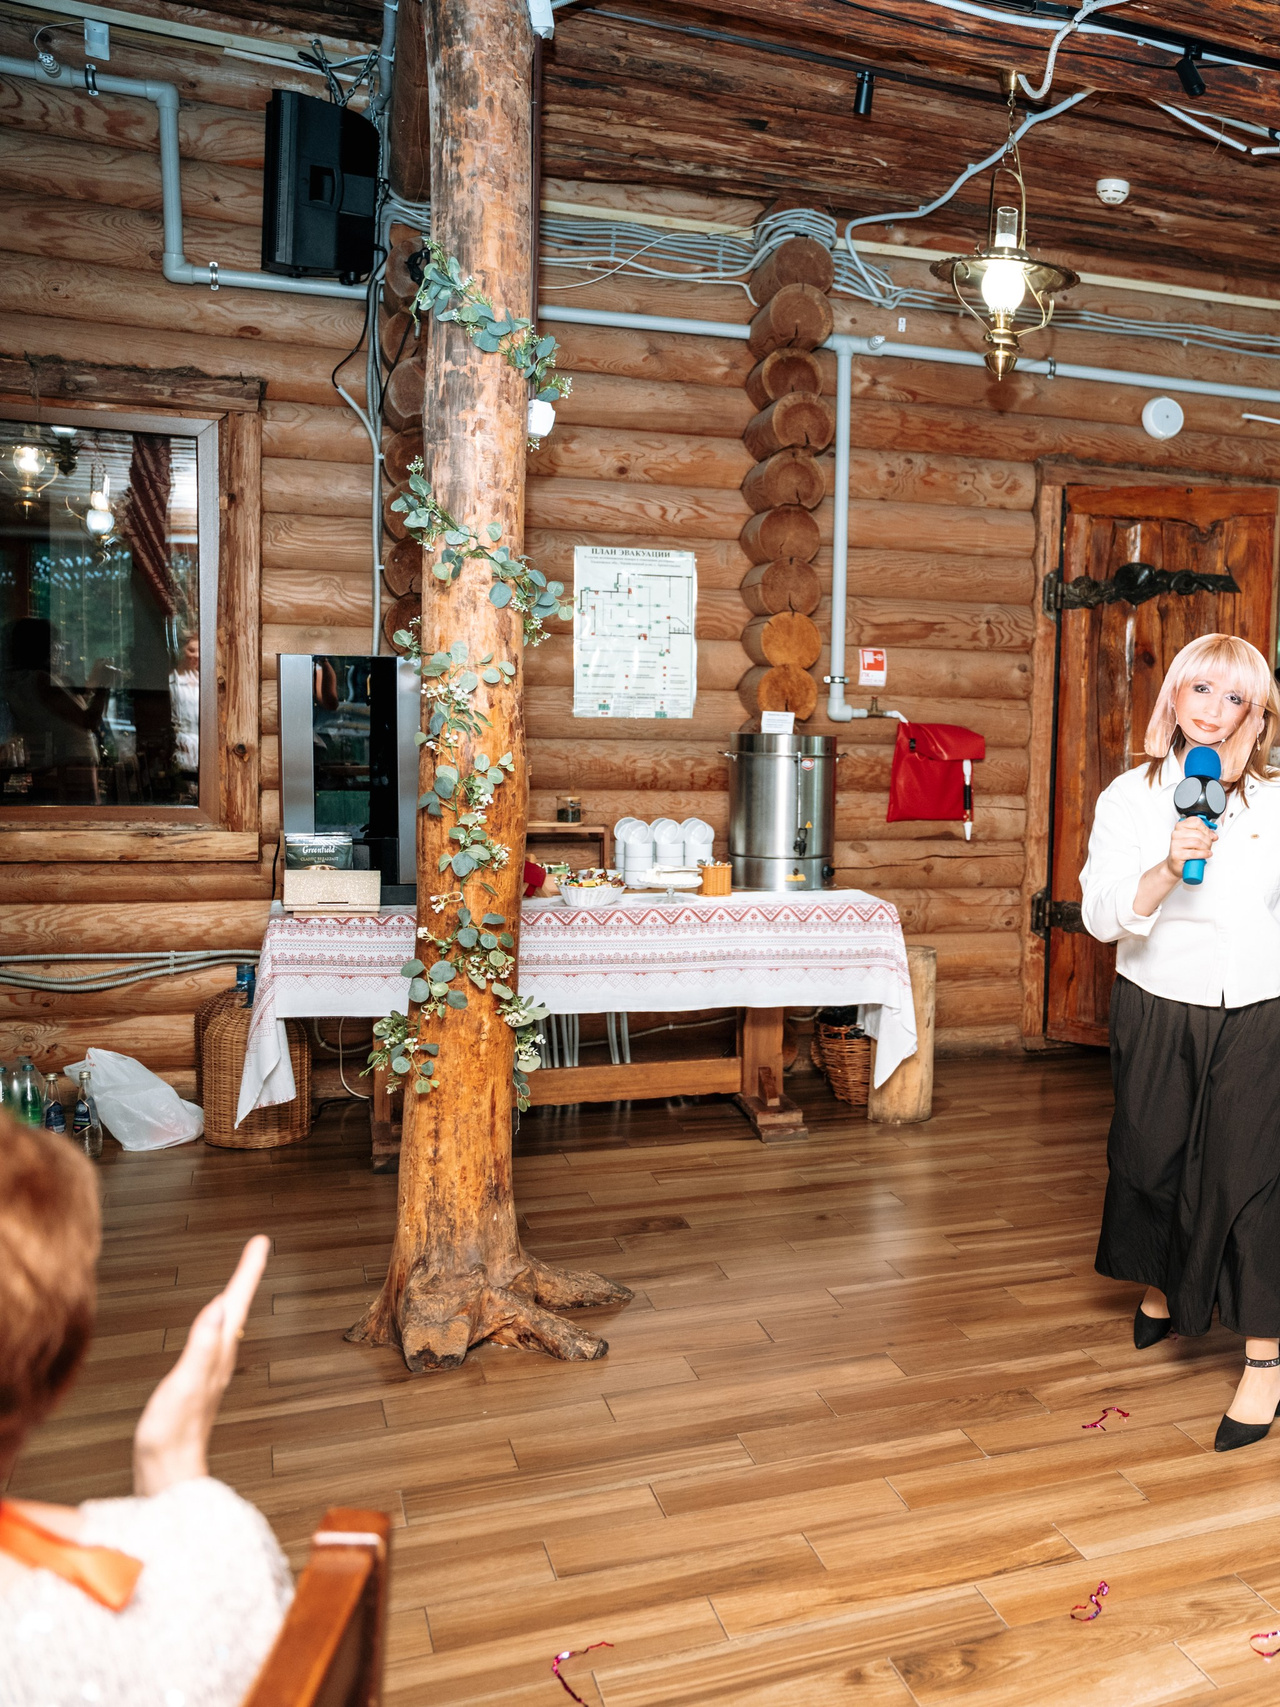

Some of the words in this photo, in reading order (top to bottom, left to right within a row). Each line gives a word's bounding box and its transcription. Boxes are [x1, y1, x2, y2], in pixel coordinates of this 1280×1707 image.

[591, 548, 617, 556] ПЛАН
[619, 549, 671, 558] ЭВАКУАЦИИ
[302, 845, 336, 854] Greenfield
